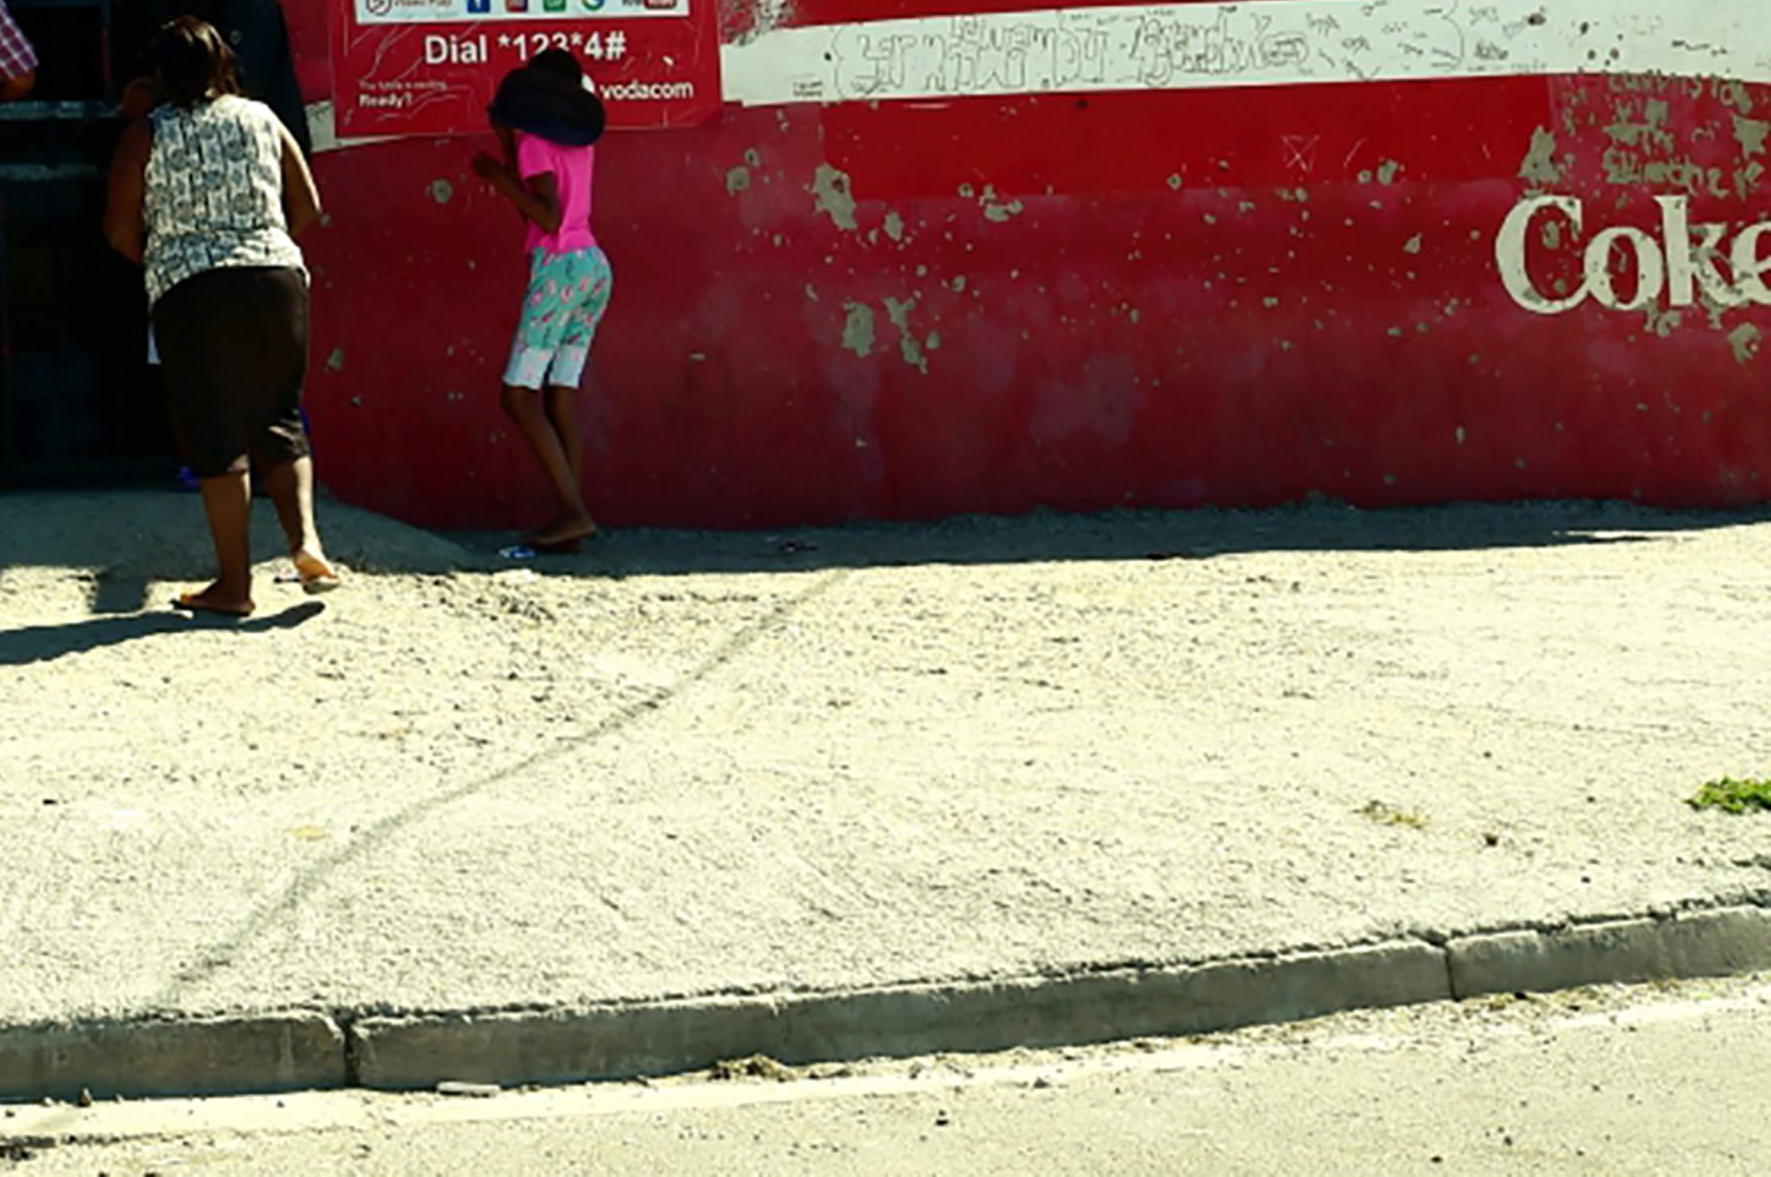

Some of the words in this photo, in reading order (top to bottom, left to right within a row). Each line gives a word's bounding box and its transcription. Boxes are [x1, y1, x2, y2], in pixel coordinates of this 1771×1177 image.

[425, 34, 487, 64] Dial
[600, 79, 694, 100] vodacom
[1495, 194, 1771, 314] Coke
